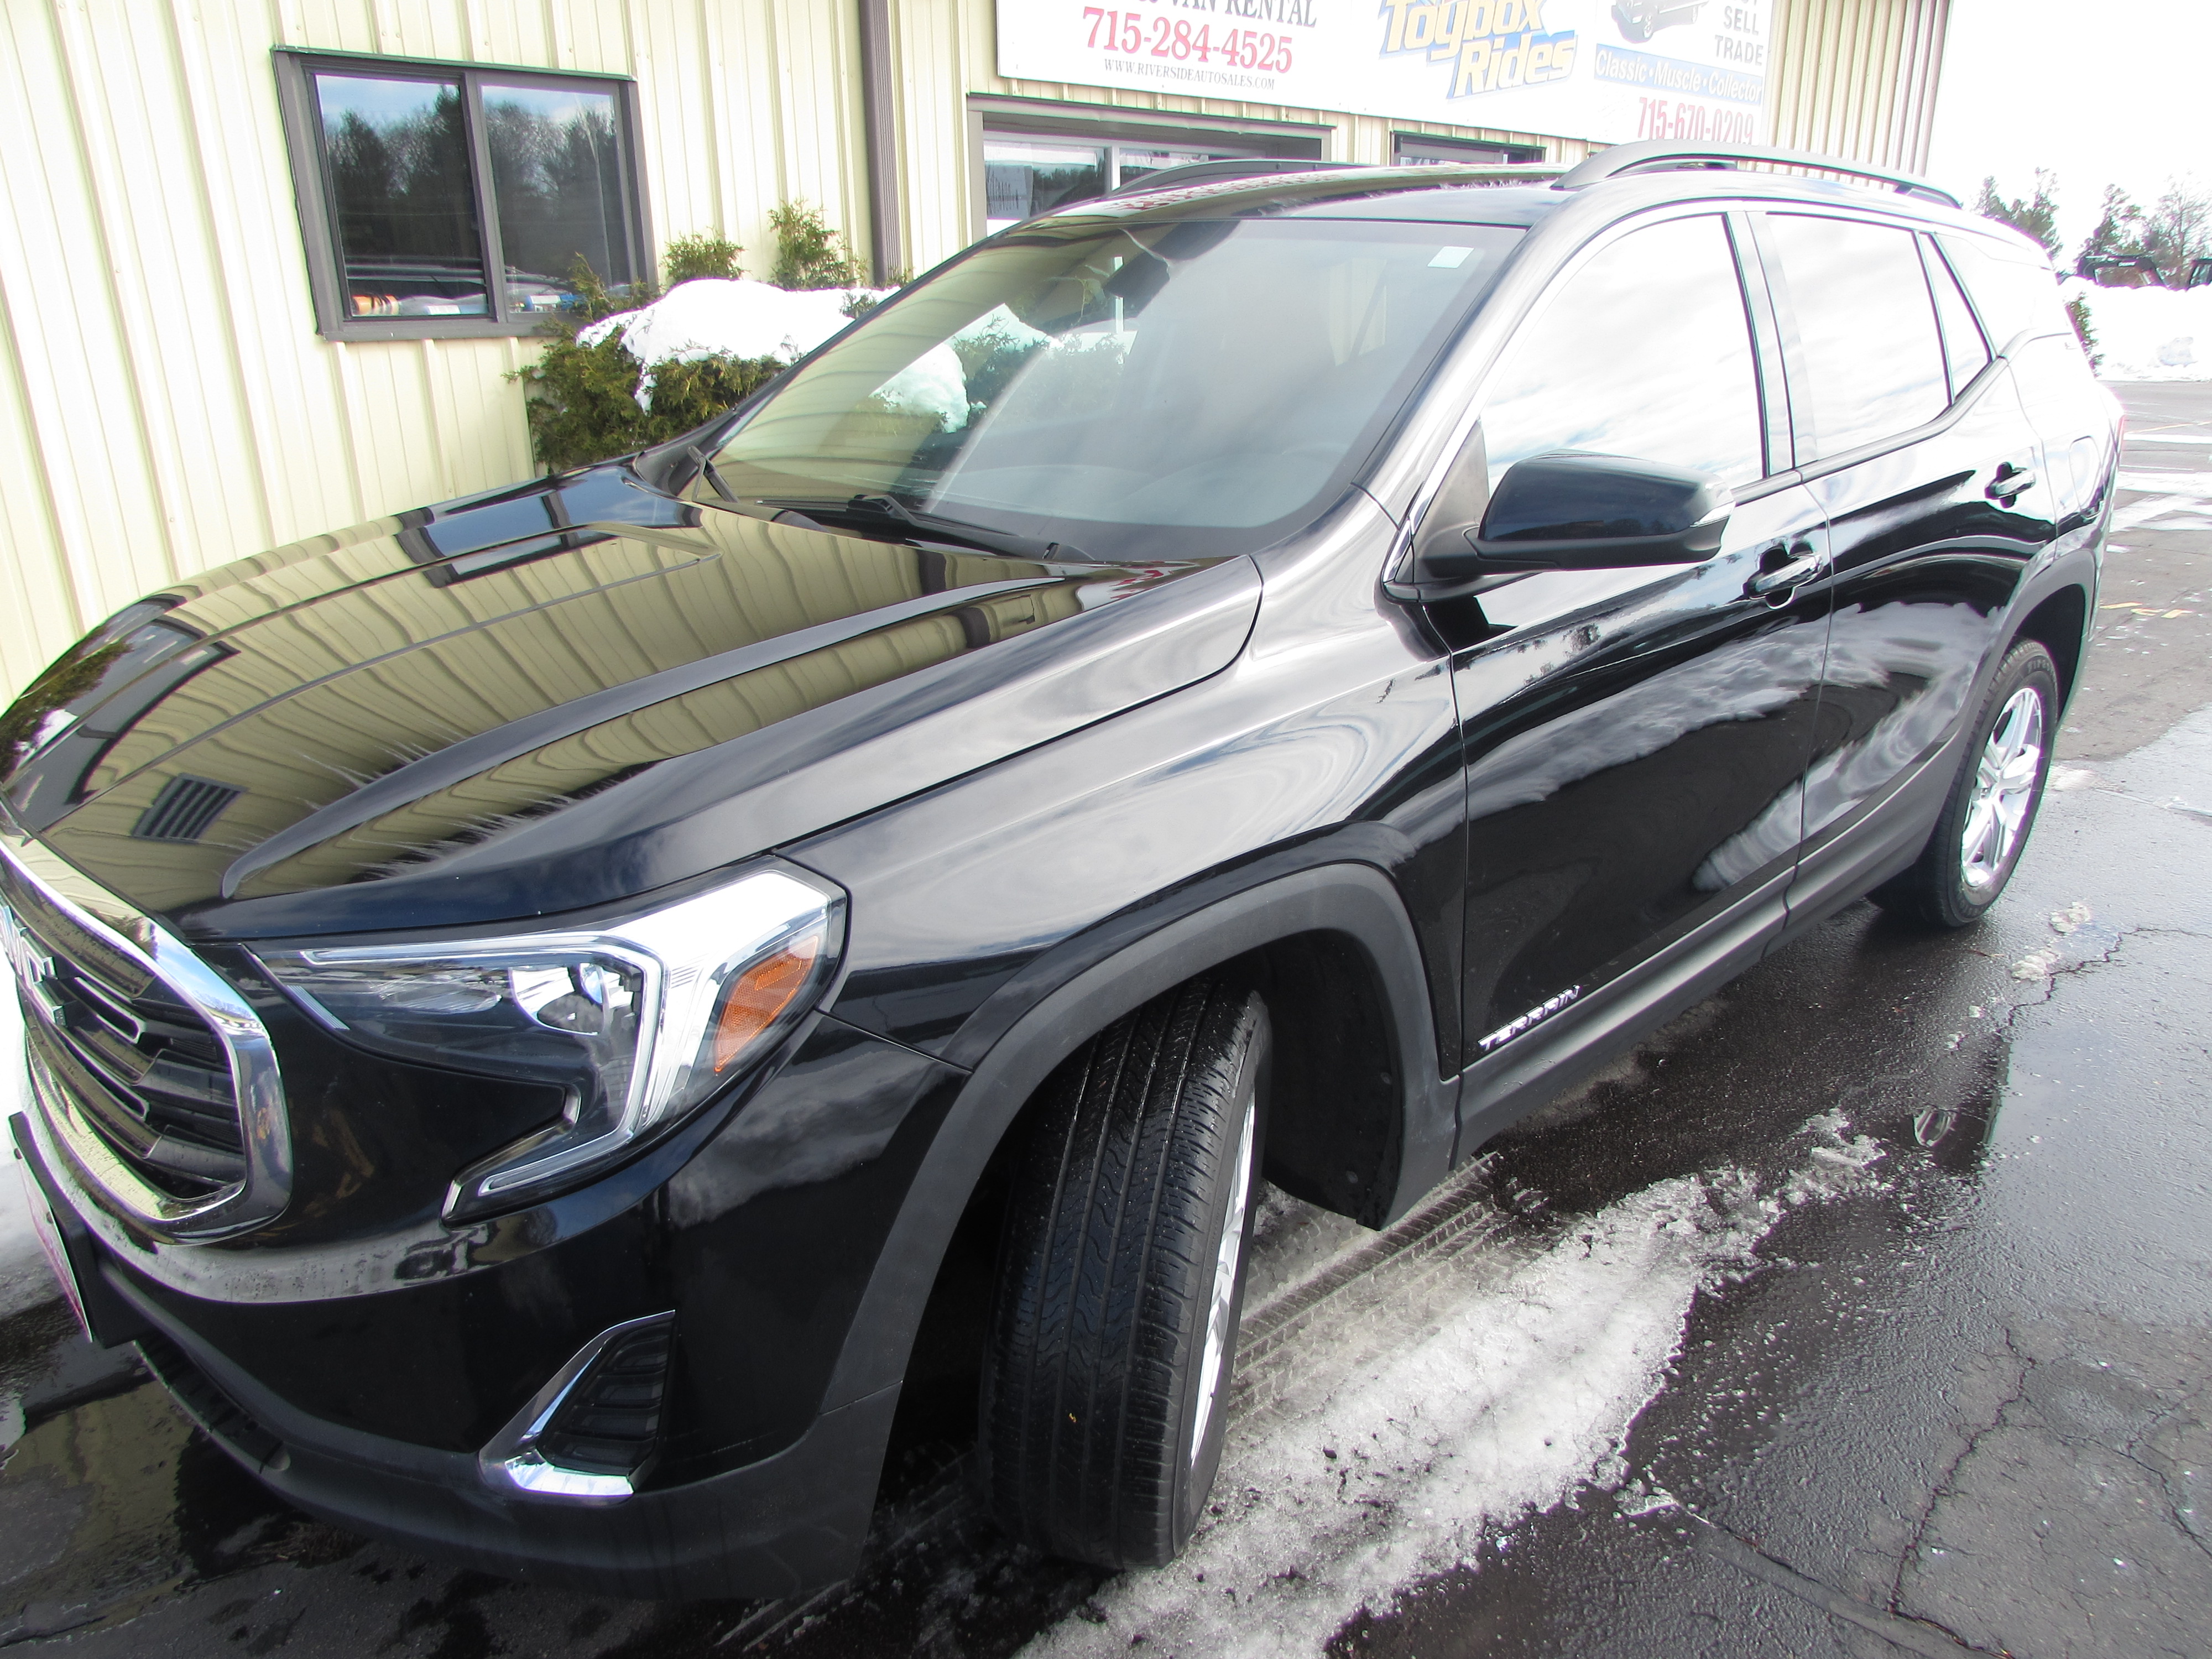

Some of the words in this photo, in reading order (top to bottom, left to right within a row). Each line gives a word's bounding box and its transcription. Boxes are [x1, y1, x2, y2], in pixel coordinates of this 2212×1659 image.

[1083, 7, 1293, 73] 715-284-4525
[1382, 0, 1545, 62] Toybox
[1723, 6, 1759, 35] SELL
[1105, 58, 1276, 91] WWW.RIVERSIDEAUTOSALES.COM
[1454, 32, 1577, 99] Rides
[1595, 49, 1647, 83] Classic
[1654, 60, 1701, 92] Muscle
[1708, 70, 1762, 102] Collector
[1715, 35, 1764, 66] TRADE
[1637, 97, 1754, 144] 715-670-0209
